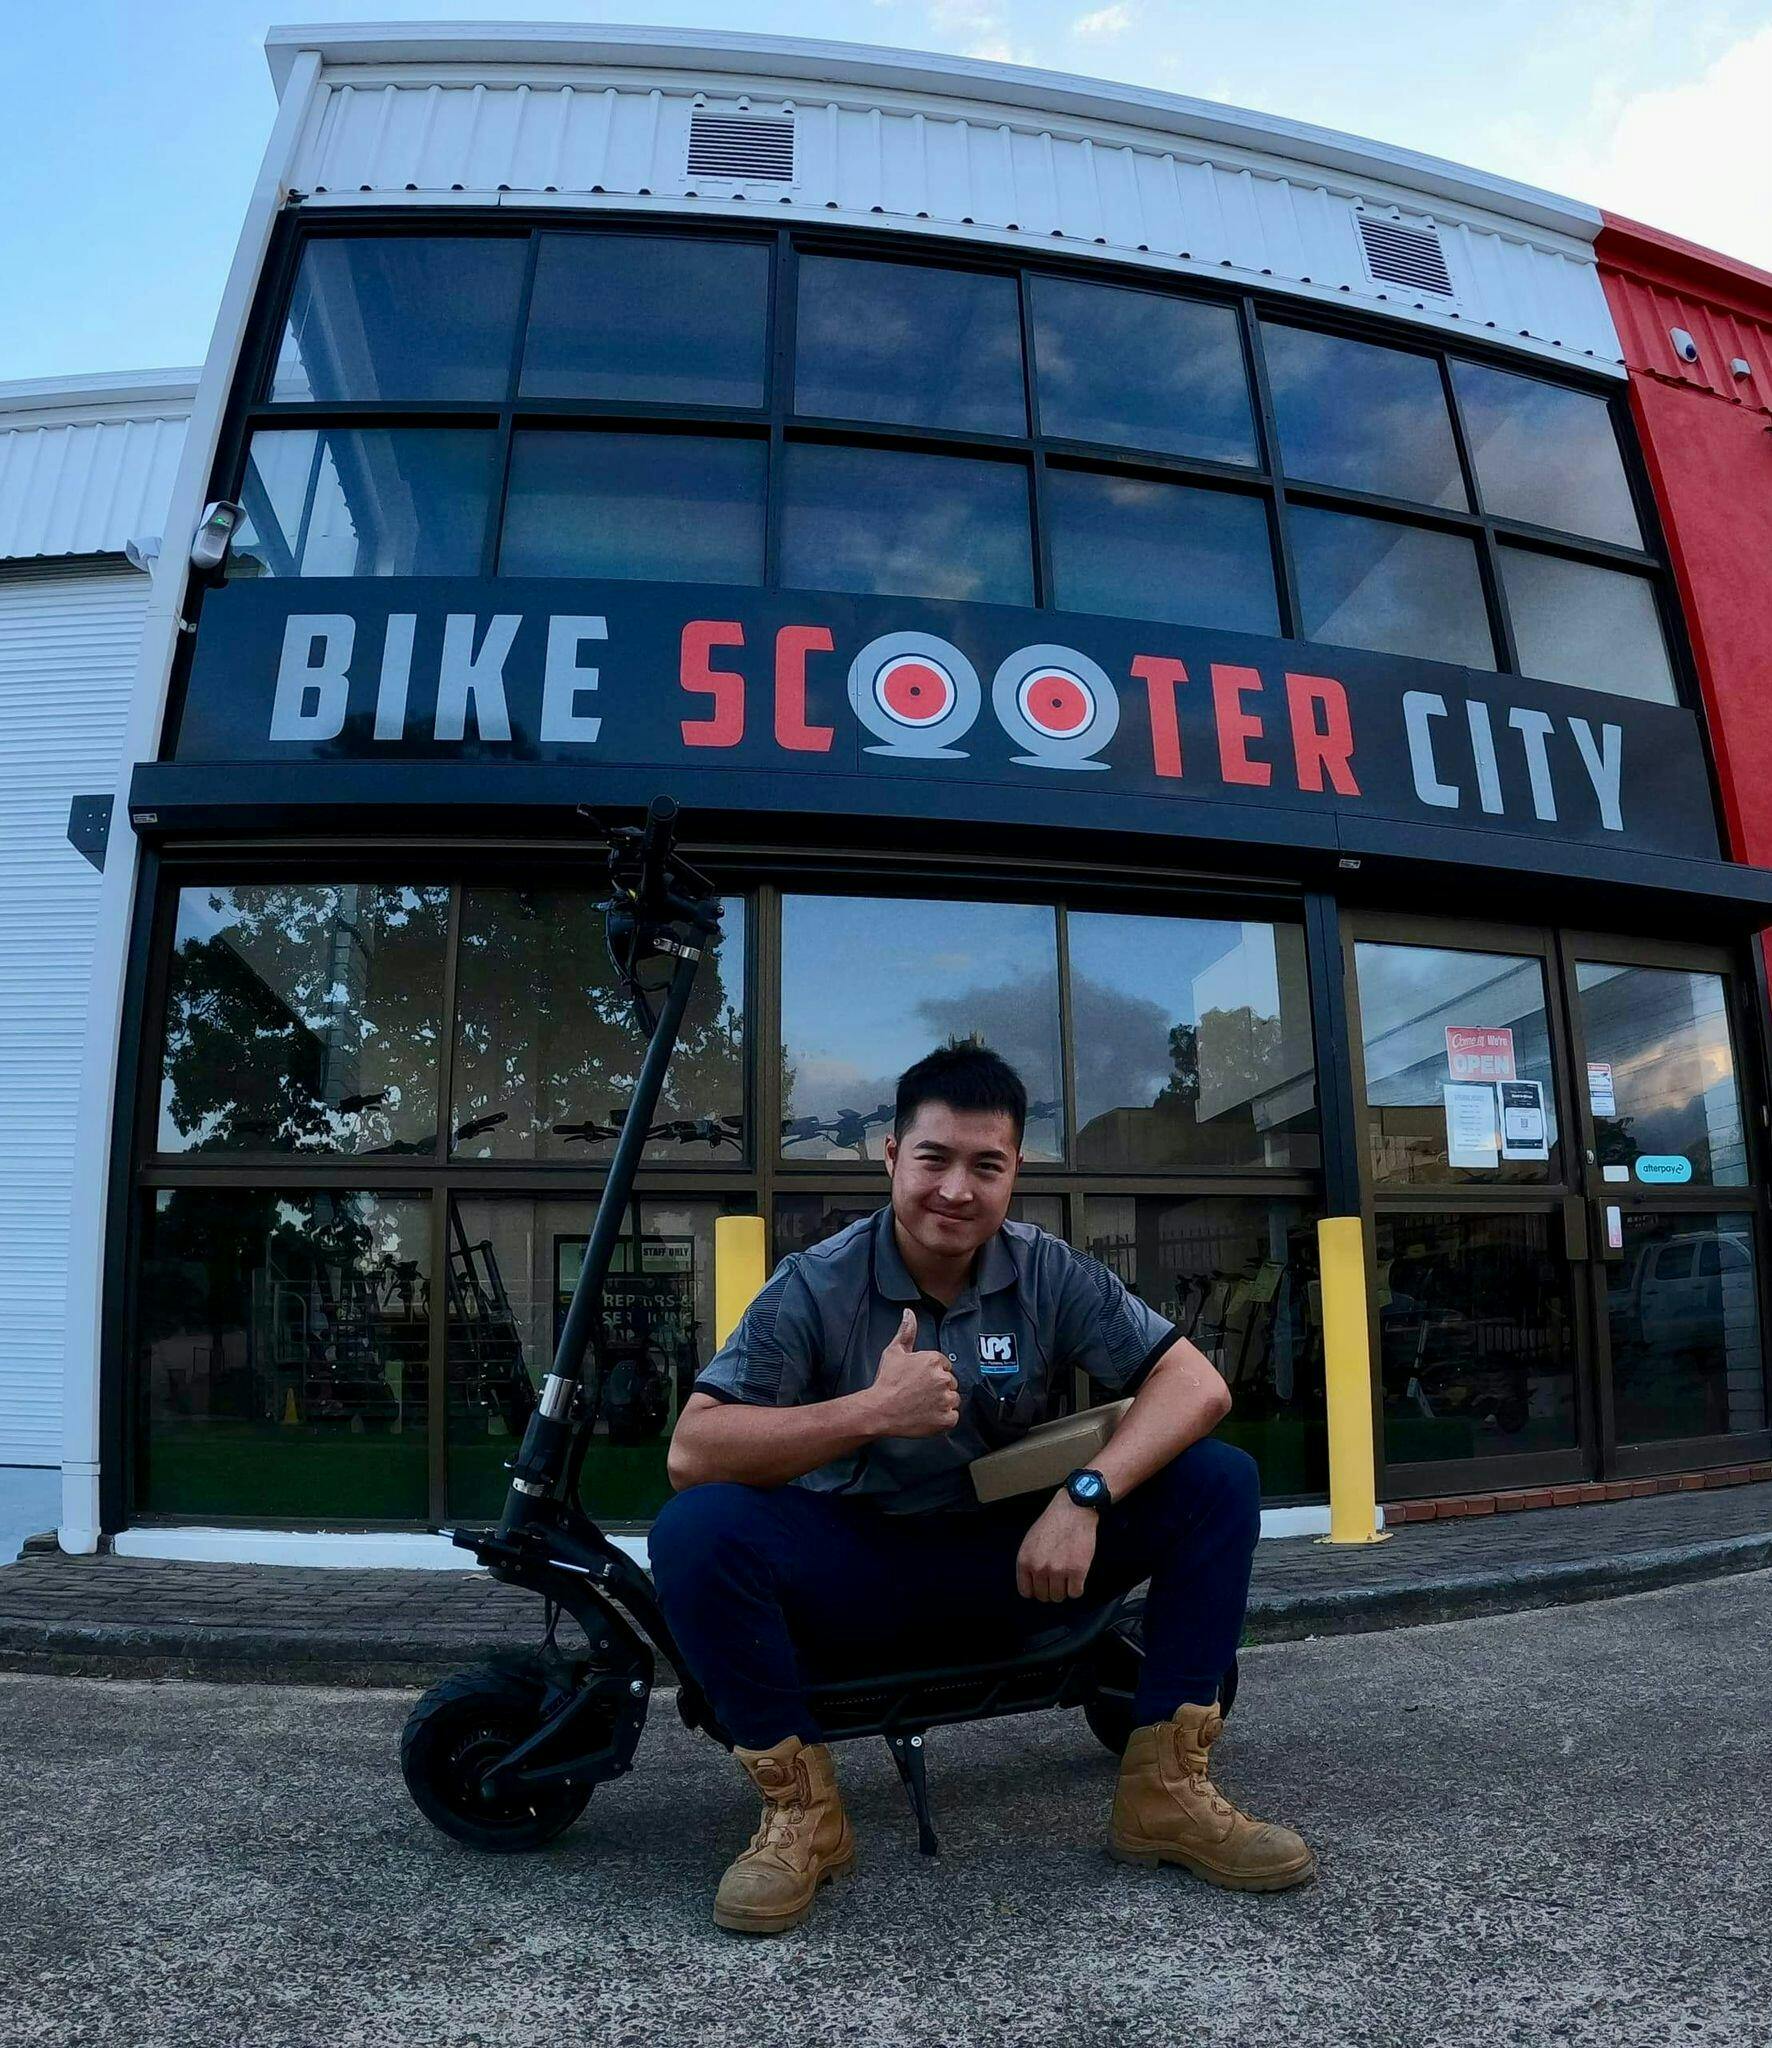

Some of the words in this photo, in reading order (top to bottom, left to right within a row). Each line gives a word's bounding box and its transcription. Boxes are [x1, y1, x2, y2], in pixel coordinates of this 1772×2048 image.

[269, 613, 609, 743] BIKE
[1402, 690, 1624, 831] CITY
[1452, 1033, 1477, 1049] Come
[1454, 1054, 1510, 1075] OPEN
[1643, 1163, 1676, 1175] afterpay
[643, 1247, 666, 1256] STAFF
[668, 1247, 690, 1256] ONLY
